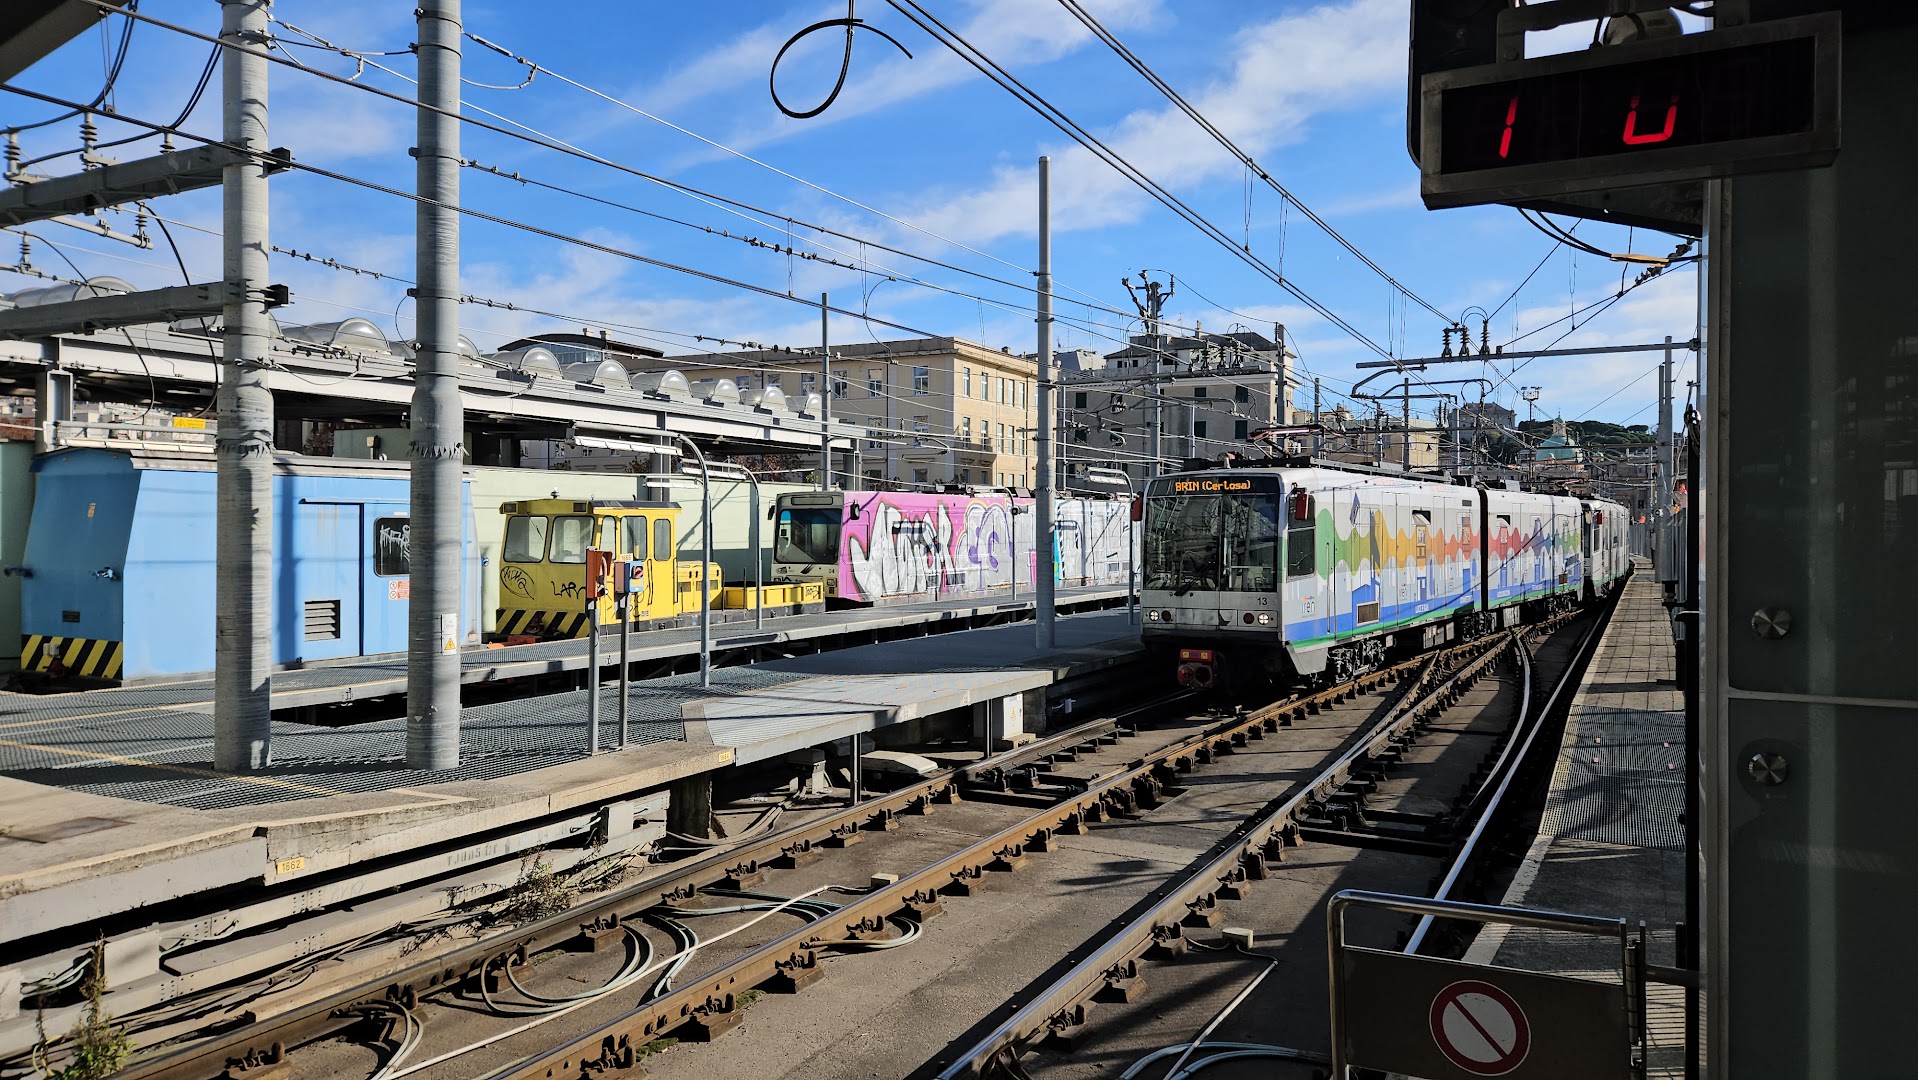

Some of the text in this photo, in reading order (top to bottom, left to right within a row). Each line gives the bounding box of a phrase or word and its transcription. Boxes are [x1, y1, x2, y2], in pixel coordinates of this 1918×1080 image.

[1498, 95, 1519, 159] 1
[1175, 479, 1251, 491] BRIN (Certosa)
[1257, 597, 1268, 606] 13
[1302, 601, 1316, 614] iren
[282, 860, 301, 871] 1662
